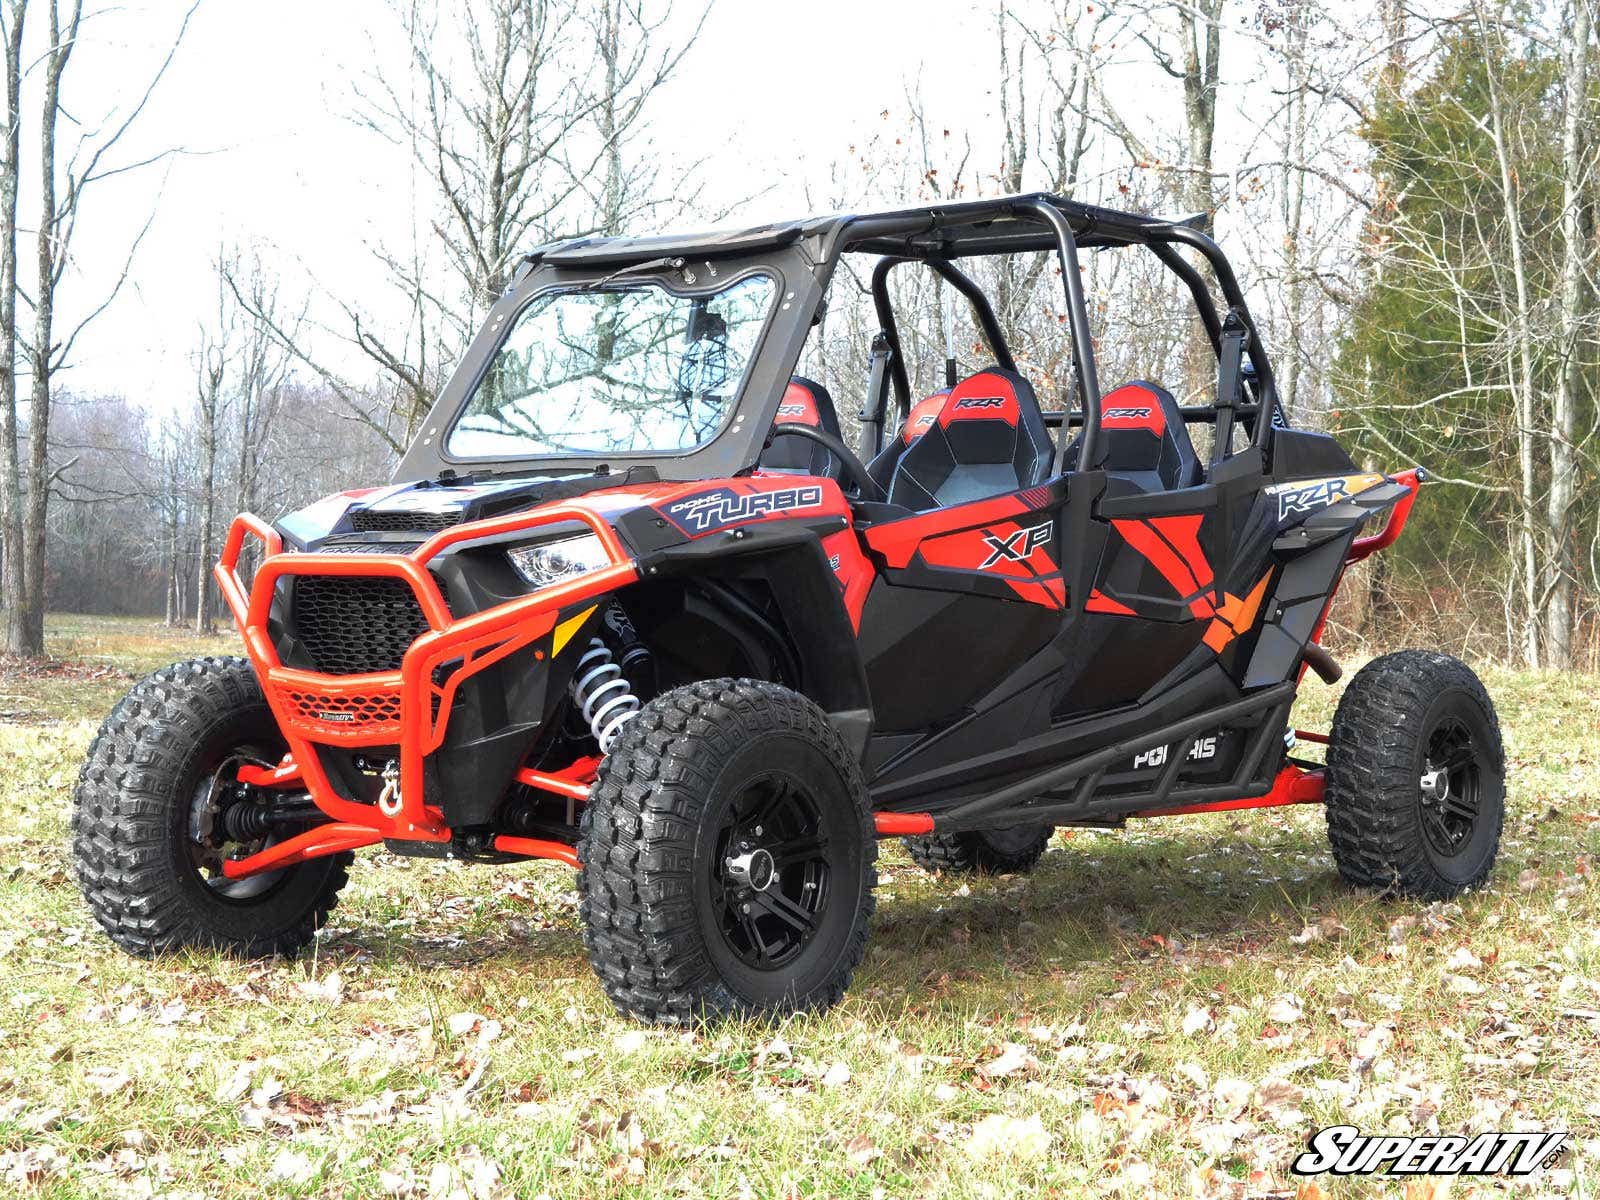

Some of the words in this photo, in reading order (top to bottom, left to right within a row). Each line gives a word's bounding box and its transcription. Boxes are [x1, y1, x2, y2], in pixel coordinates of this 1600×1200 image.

[953, 397, 1005, 410] RZR
[1102, 407, 1152, 420] RZR
[670, 493, 722, 513] DOHC
[685, 485, 822, 529] TURBO
[1279, 477, 1354, 522] RZR
[977, 519, 1053, 570] XP
